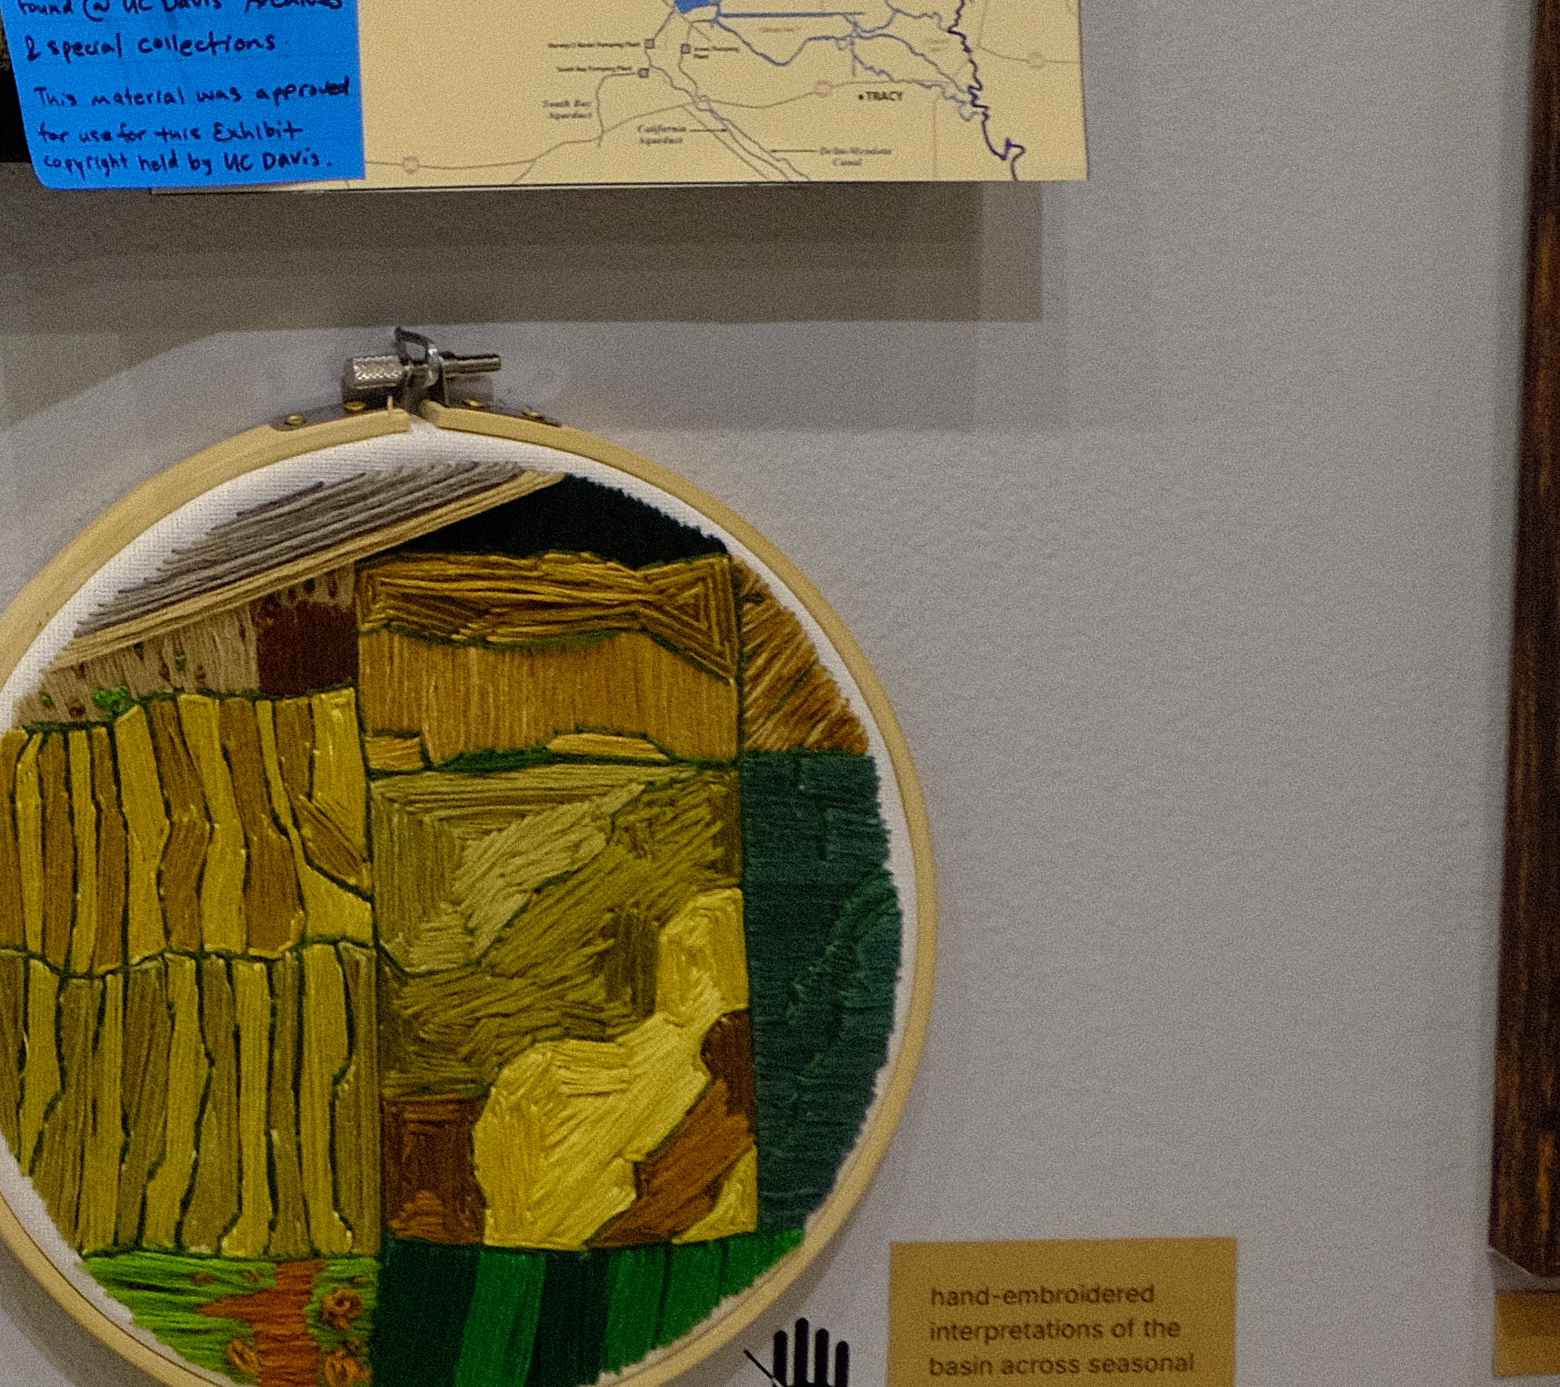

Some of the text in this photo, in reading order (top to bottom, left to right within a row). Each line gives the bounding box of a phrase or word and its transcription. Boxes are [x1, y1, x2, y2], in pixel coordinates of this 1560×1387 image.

[866, 90, 903, 102] TRACY
[44, 152, 128, 179] copyright
[139, 152, 178, 171] held
[189, 153, 212, 175] by
[224, 152, 253, 171] UC
[932, 1284, 1155, 1308] hand-embroidered
[930, 1319, 1181, 1344] interpretations of the
[929, 1353, 1193, 1377] basin across seasonal
